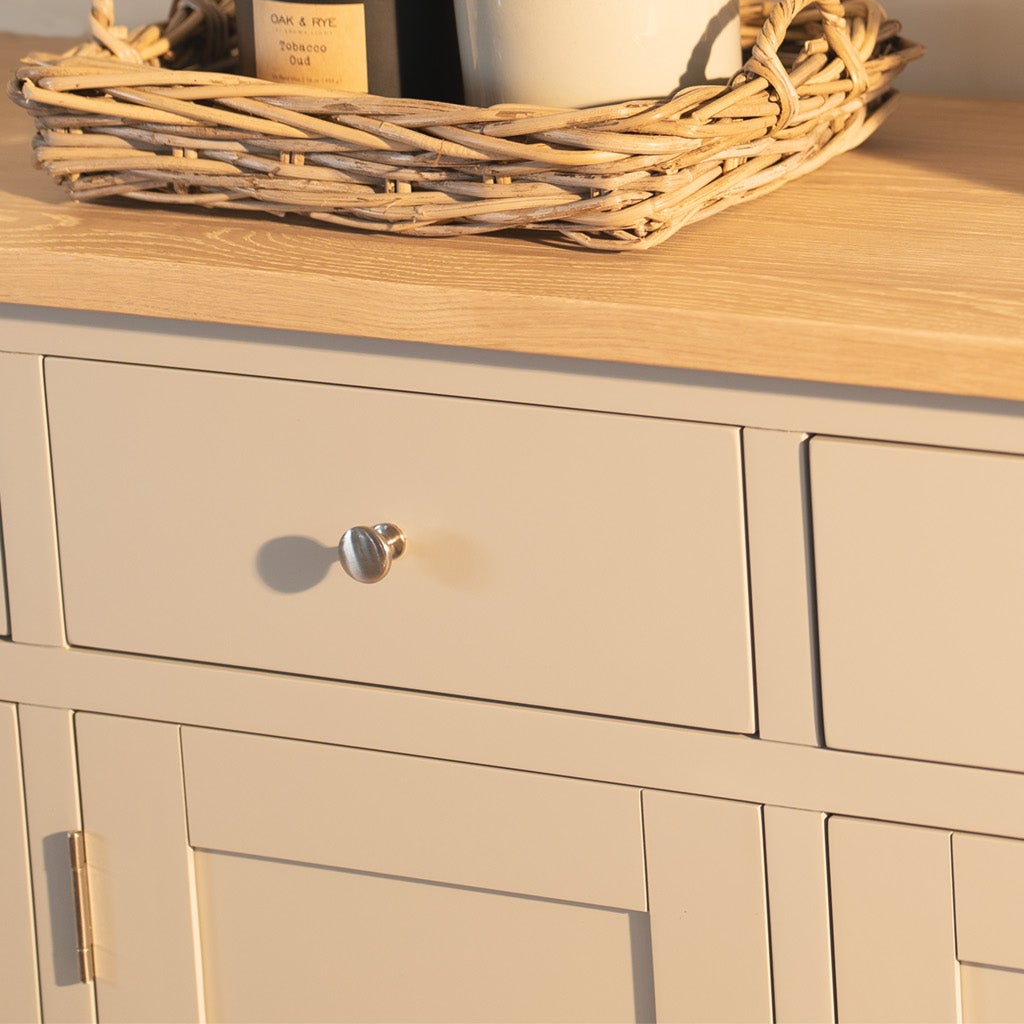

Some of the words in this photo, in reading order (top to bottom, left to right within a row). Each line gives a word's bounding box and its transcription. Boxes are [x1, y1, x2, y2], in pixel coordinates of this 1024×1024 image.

[270, 13, 294, 26] OAK
[298, 16, 306, 26] &
[311, 17, 337, 28] RYE
[279, 40, 327, 53] Tobacco
[289, 55, 311, 66] Oud
